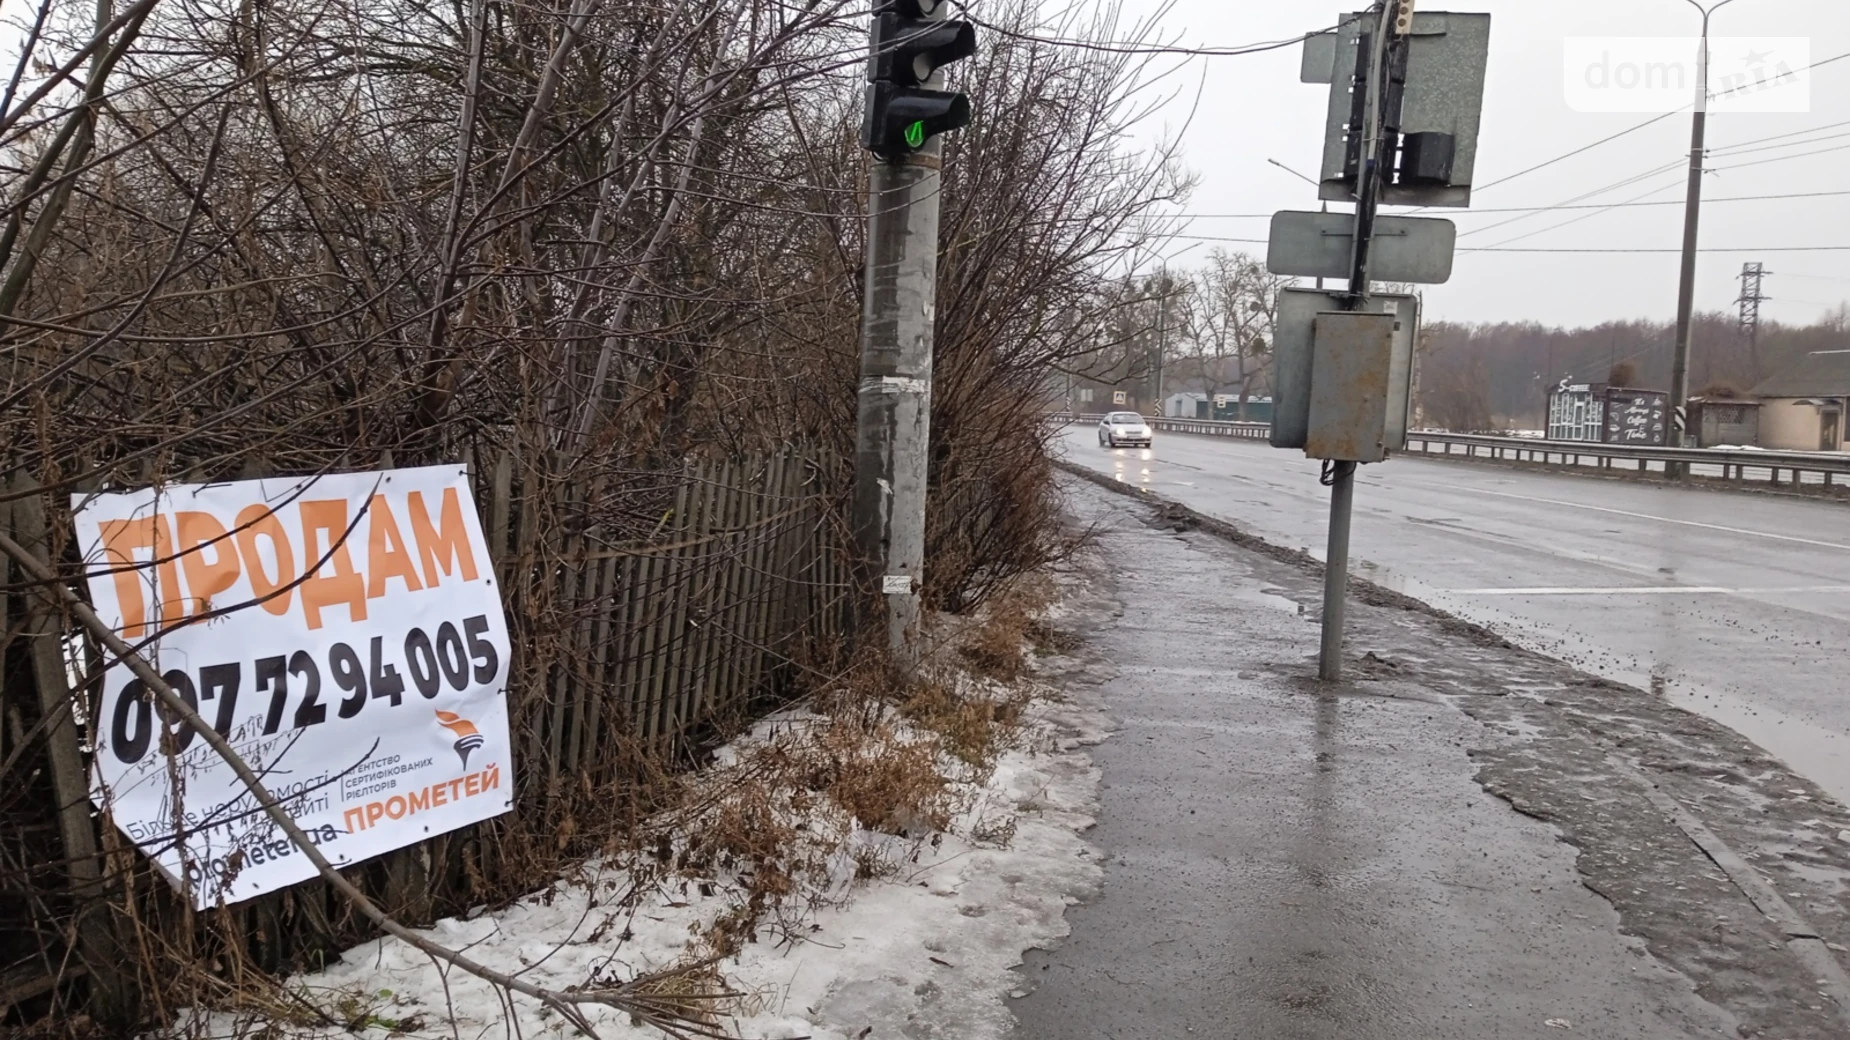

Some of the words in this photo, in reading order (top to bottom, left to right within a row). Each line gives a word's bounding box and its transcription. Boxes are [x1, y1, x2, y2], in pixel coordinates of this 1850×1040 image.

[98, 487, 479, 638] ПРОДАМ
[126, 811, 199, 840] Білье
[202, 770, 329, 819] неруомості
[344, 762, 499, 834] ПРОМЕТЕЙ
[345, 757, 433, 788] СЕРТИФІКОВАНИХ
[346, 779, 397, 800] РІЄЛТОРІВ
